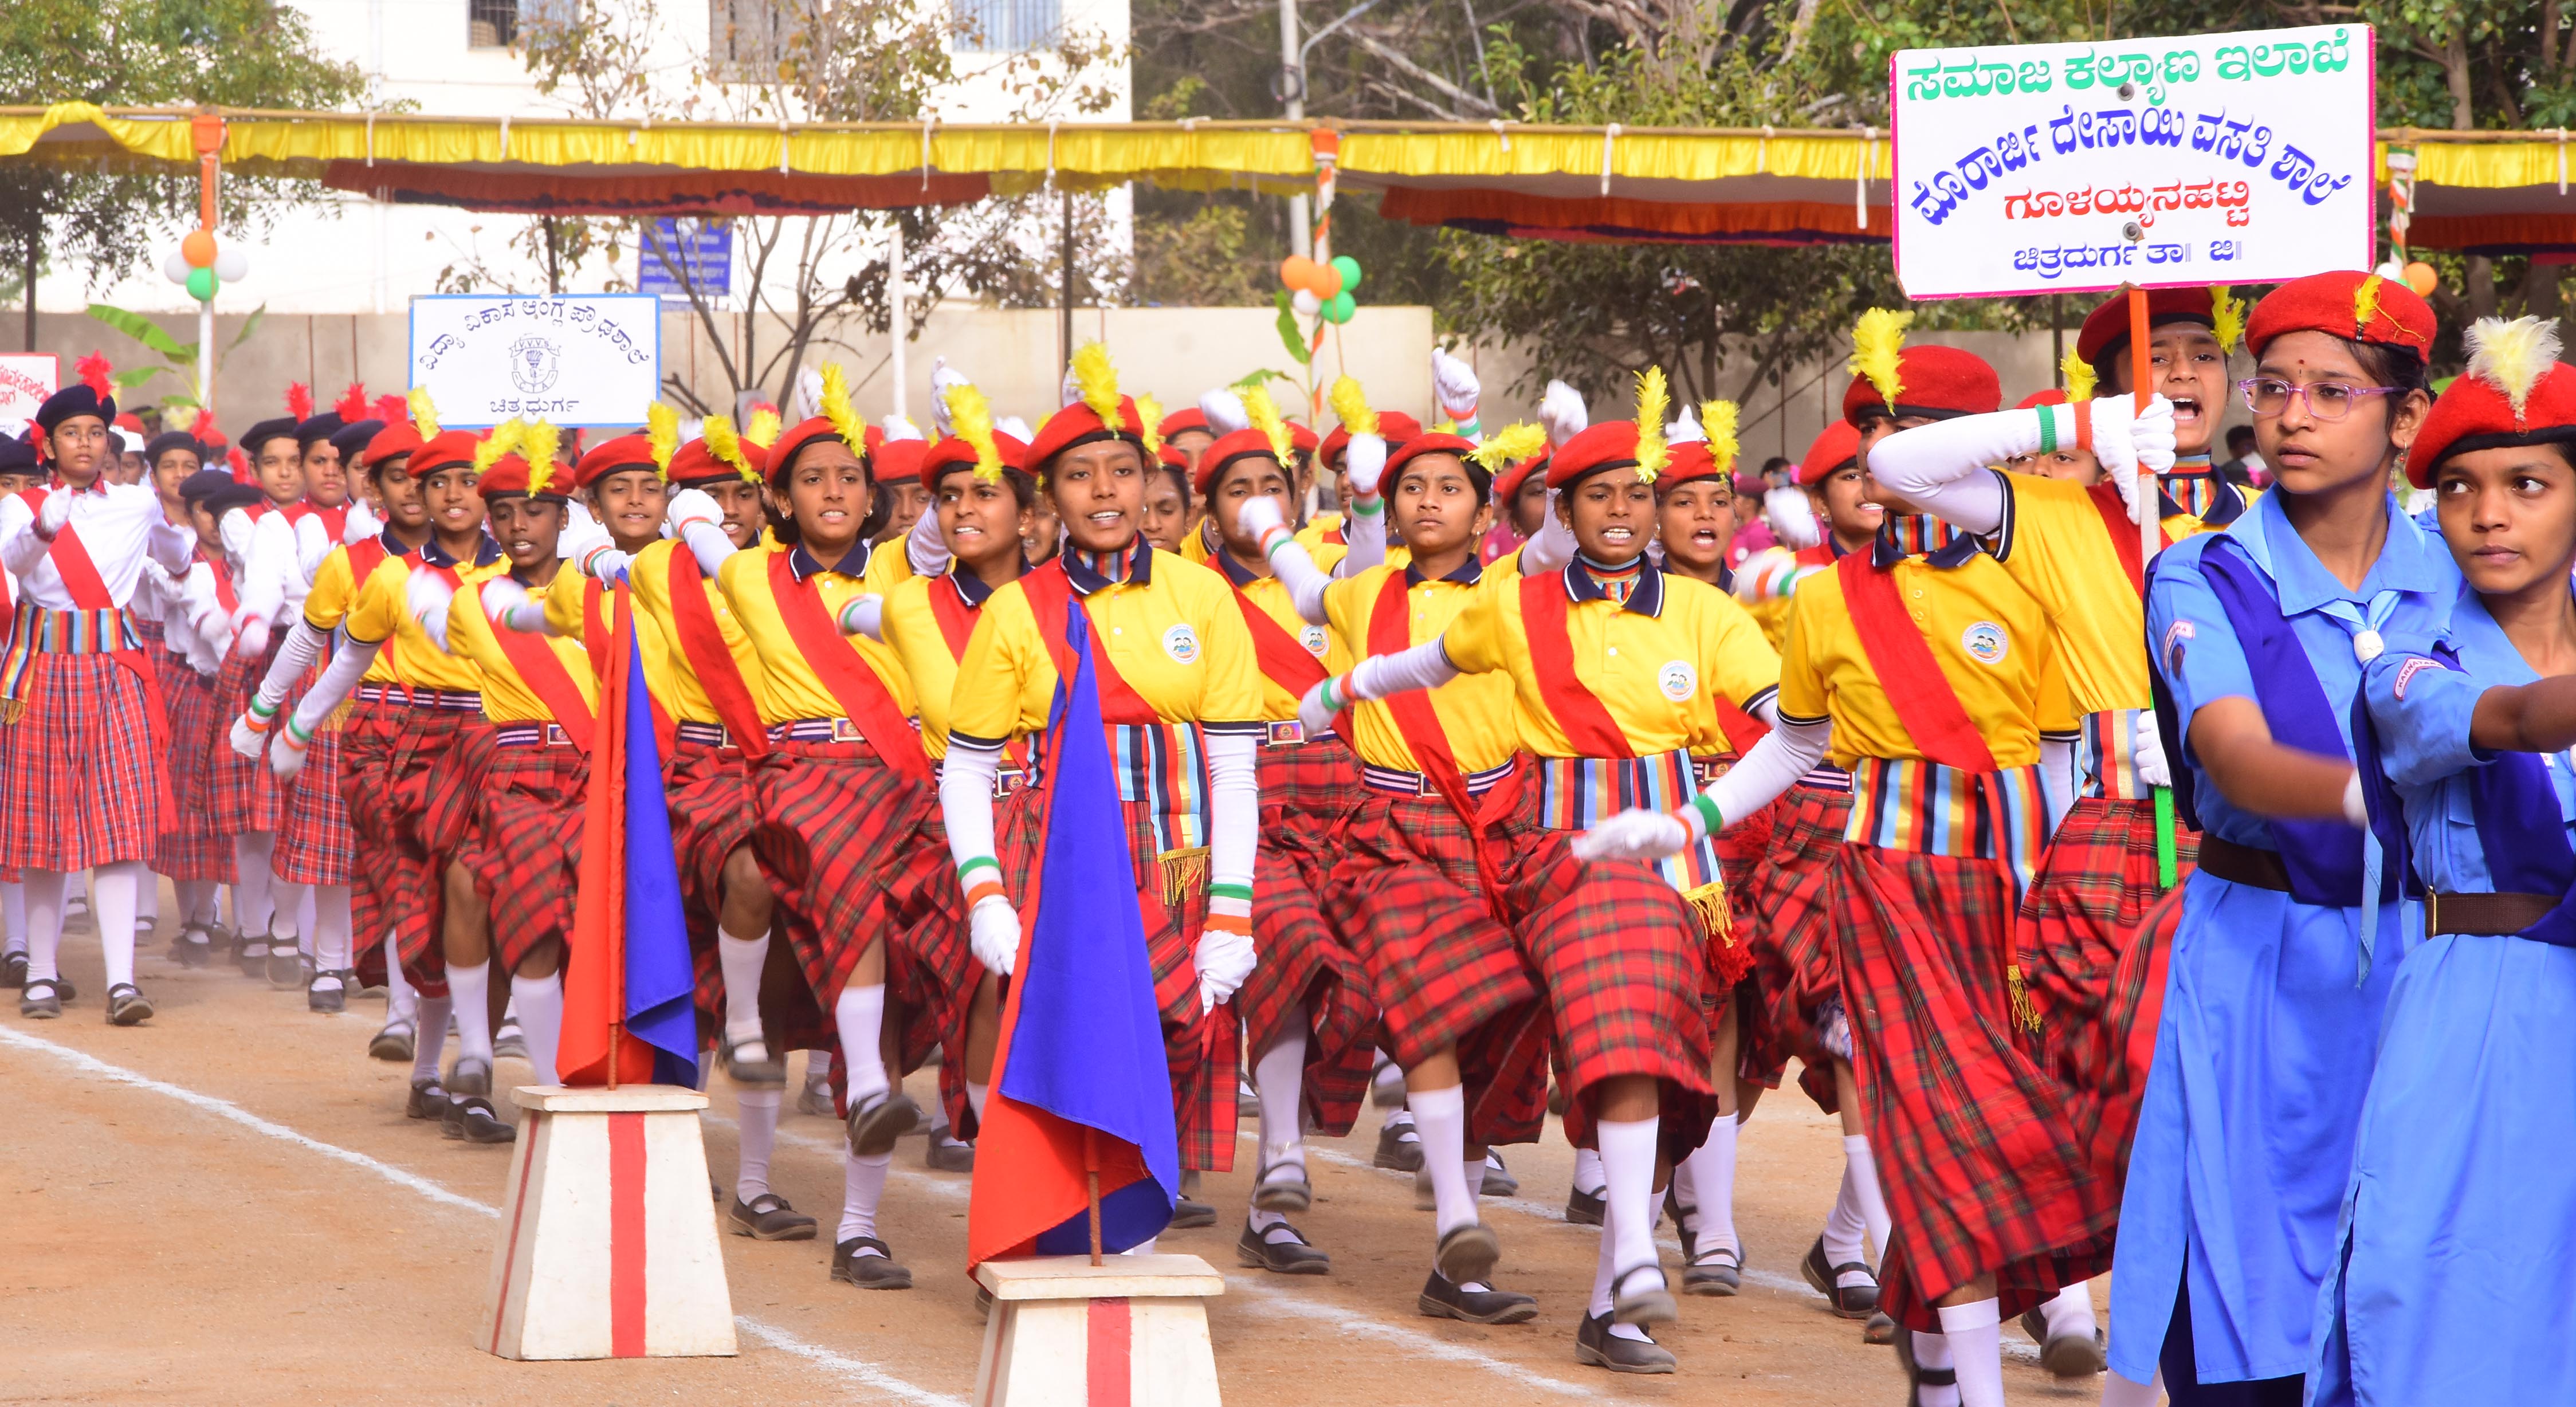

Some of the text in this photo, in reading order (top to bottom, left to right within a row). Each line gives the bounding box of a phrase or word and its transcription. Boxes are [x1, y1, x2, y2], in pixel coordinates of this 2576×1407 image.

[1908, 28, 2349, 107] ಸಮಾಜ ಕಲ್ಯಾಣ ಇಲಾಖೆ
[2049, 104, 2184, 155] ದೇಸಾಯಿ
[2192, 108, 2272, 167] ವಸತಿ
[2271, 144, 2351, 206] ಶಾಲೆ
[2013, 243, 2138, 279] ಚಿತ್ರದುರ್ಗ
[419, 333, 465, 370] ವಿದ್ಯಾ
[464, 298, 515, 332] ವಿಕಾಸ
